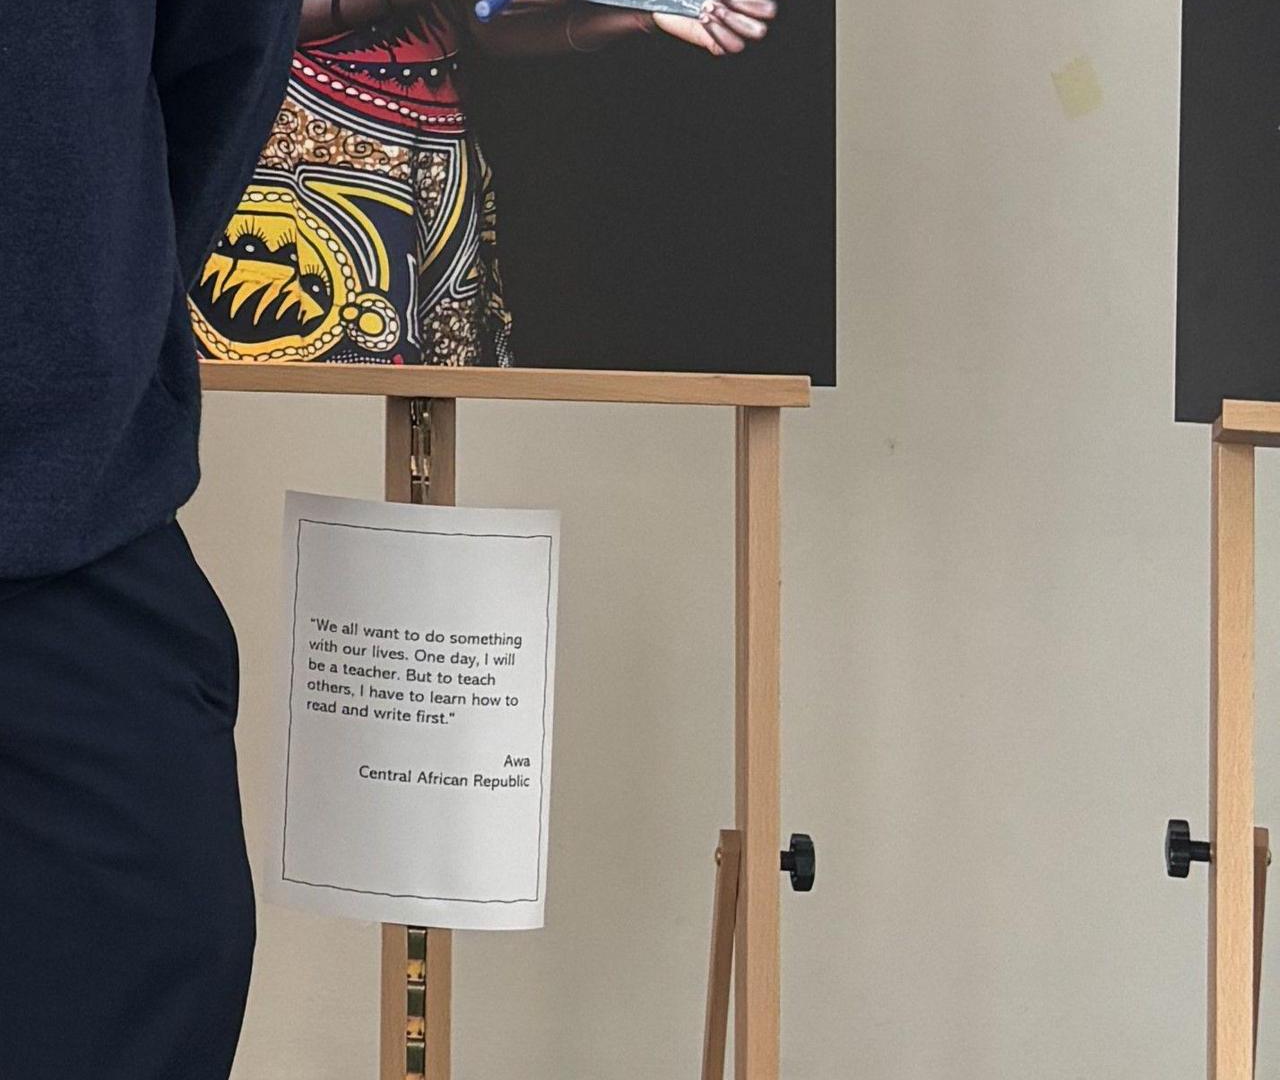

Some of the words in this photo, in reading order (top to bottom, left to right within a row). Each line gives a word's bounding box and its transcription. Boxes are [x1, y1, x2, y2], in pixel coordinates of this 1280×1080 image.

[342, 622, 358, 636] all
[363, 627, 399, 640] want
[404, 629, 420, 642] to
[425, 629, 445, 644] do
[450, 632, 522, 649] something
[309, 638, 338, 653] with
[342, 645, 367, 657] our
[372, 644, 408, 661] lives.
[414, 648, 445, 664] One
[450, 651, 479, 668] day,
[493, 652, 515, 666] will
[309, 657, 325, 672] be
[330, 663, 338, 674] a
[343, 663, 400, 681] teacher.
[406, 668, 432, 684] But
[437, 671, 453, 685] to
[458, 672, 496, 686] teach
[307, 679, 354, 698] others,
[369, 684, 404, 701] have
[409, 690, 424, 703] to
[430, 690, 466, 705] learn
[472, 692, 501, 706] how
[505, 695, 519, 707] to
[307, 700, 336, 714] read
[342, 704, 369, 718] and
[373, 707, 411, 722] write
[504, 754, 530, 768] Awa
[359, 765, 412, 783] Central
[417, 771, 468, 787] African
[473, 773, 530, 791] Republic
